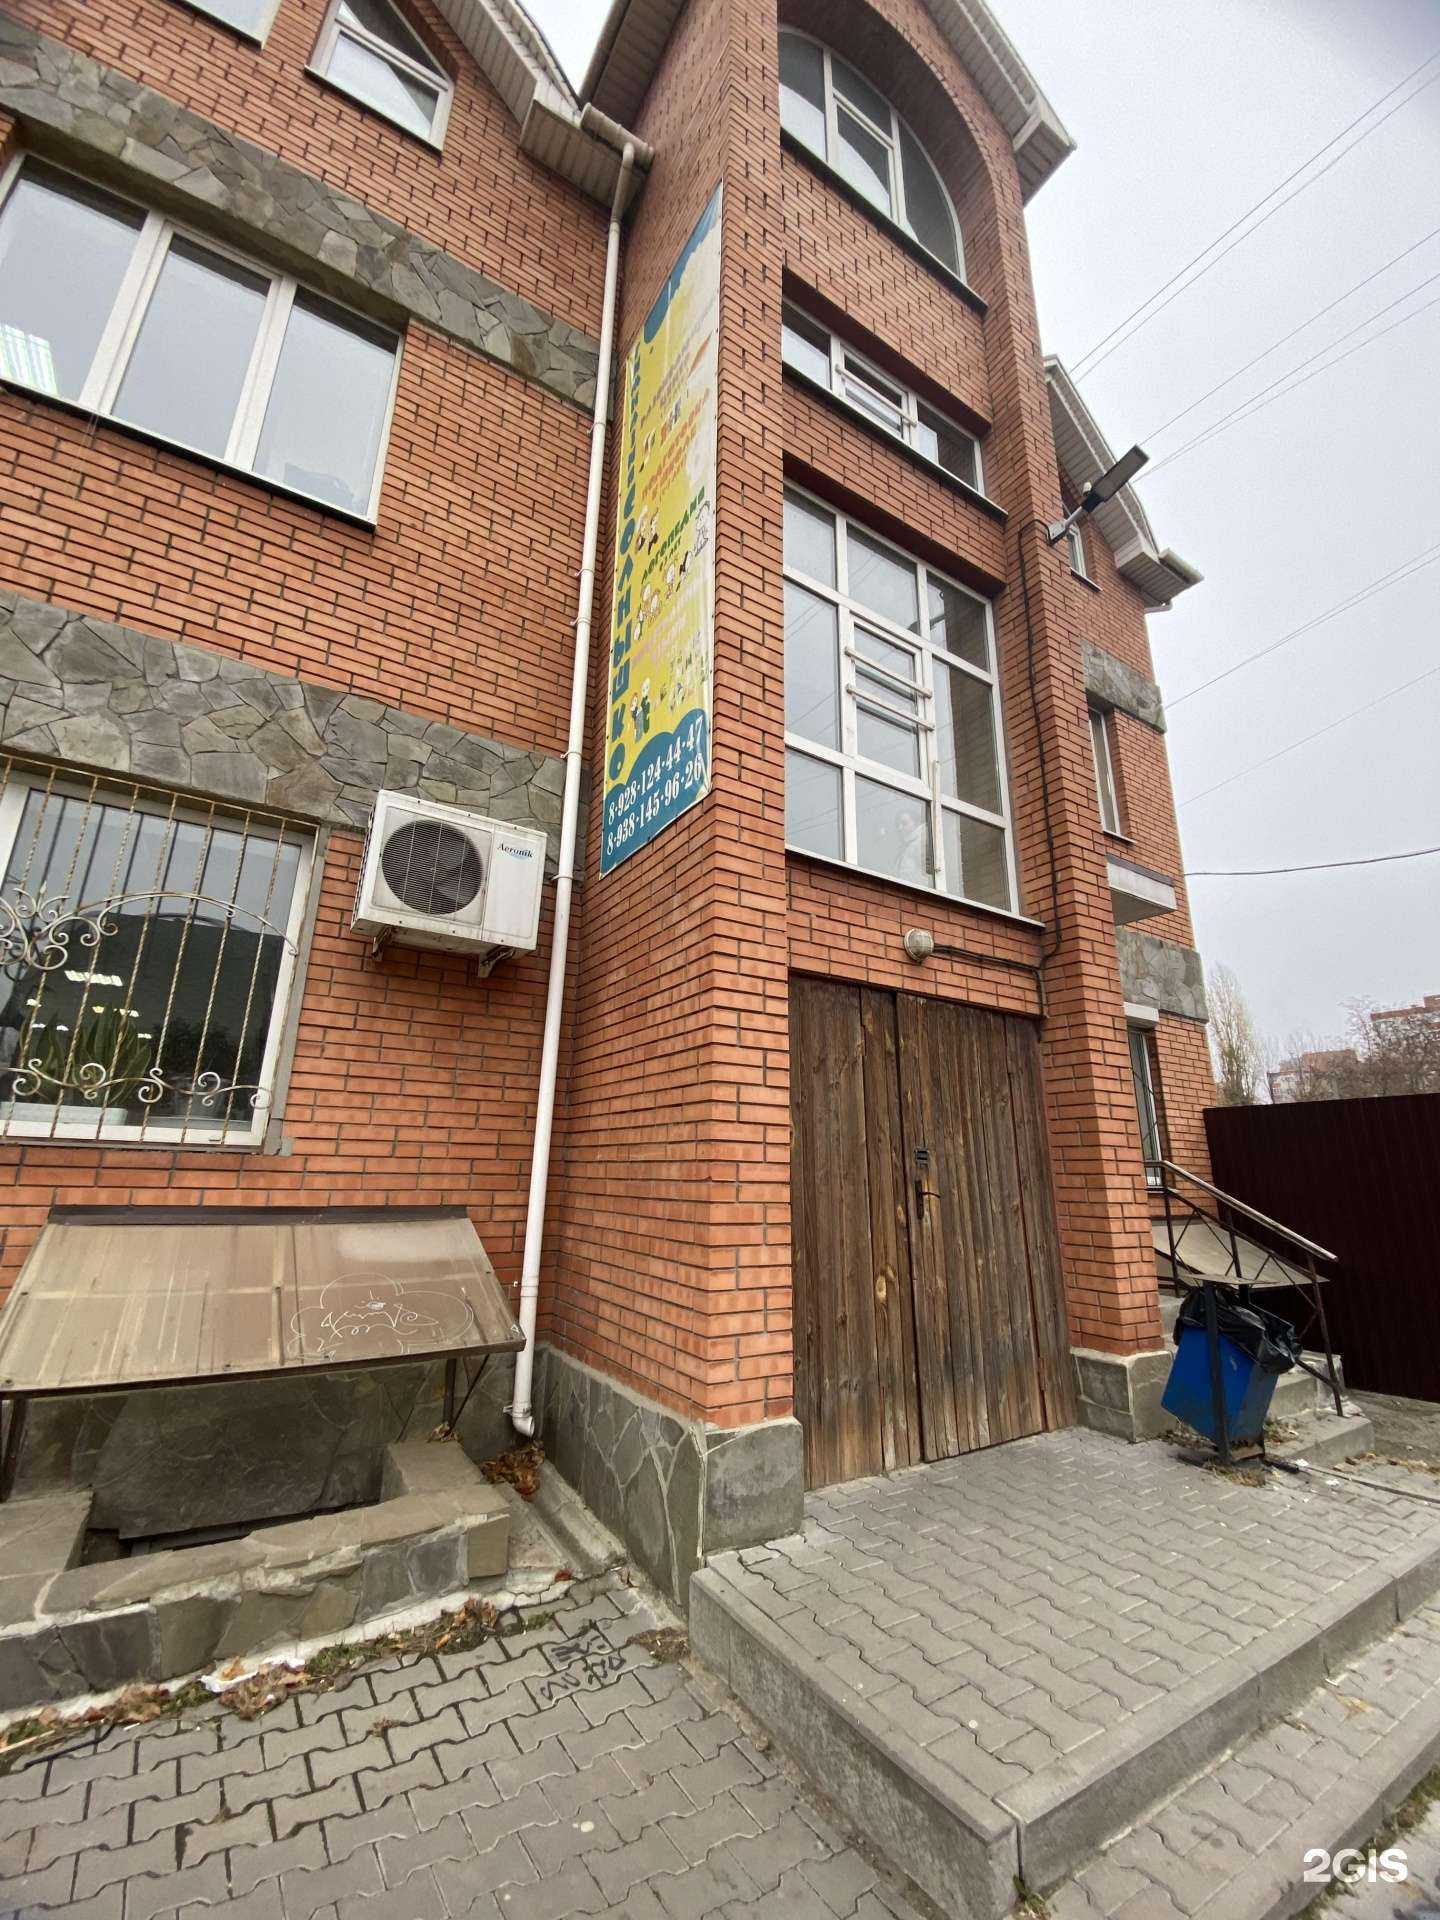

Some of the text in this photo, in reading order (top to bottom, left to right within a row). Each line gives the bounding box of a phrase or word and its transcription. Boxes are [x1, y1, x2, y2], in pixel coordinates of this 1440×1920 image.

[640, 484, 704, 585] ЛОГОПЕДИЯ
[609, 482, 636, 781] СОЛНЫШКО
[496, 842, 534, 858] Aeronik
